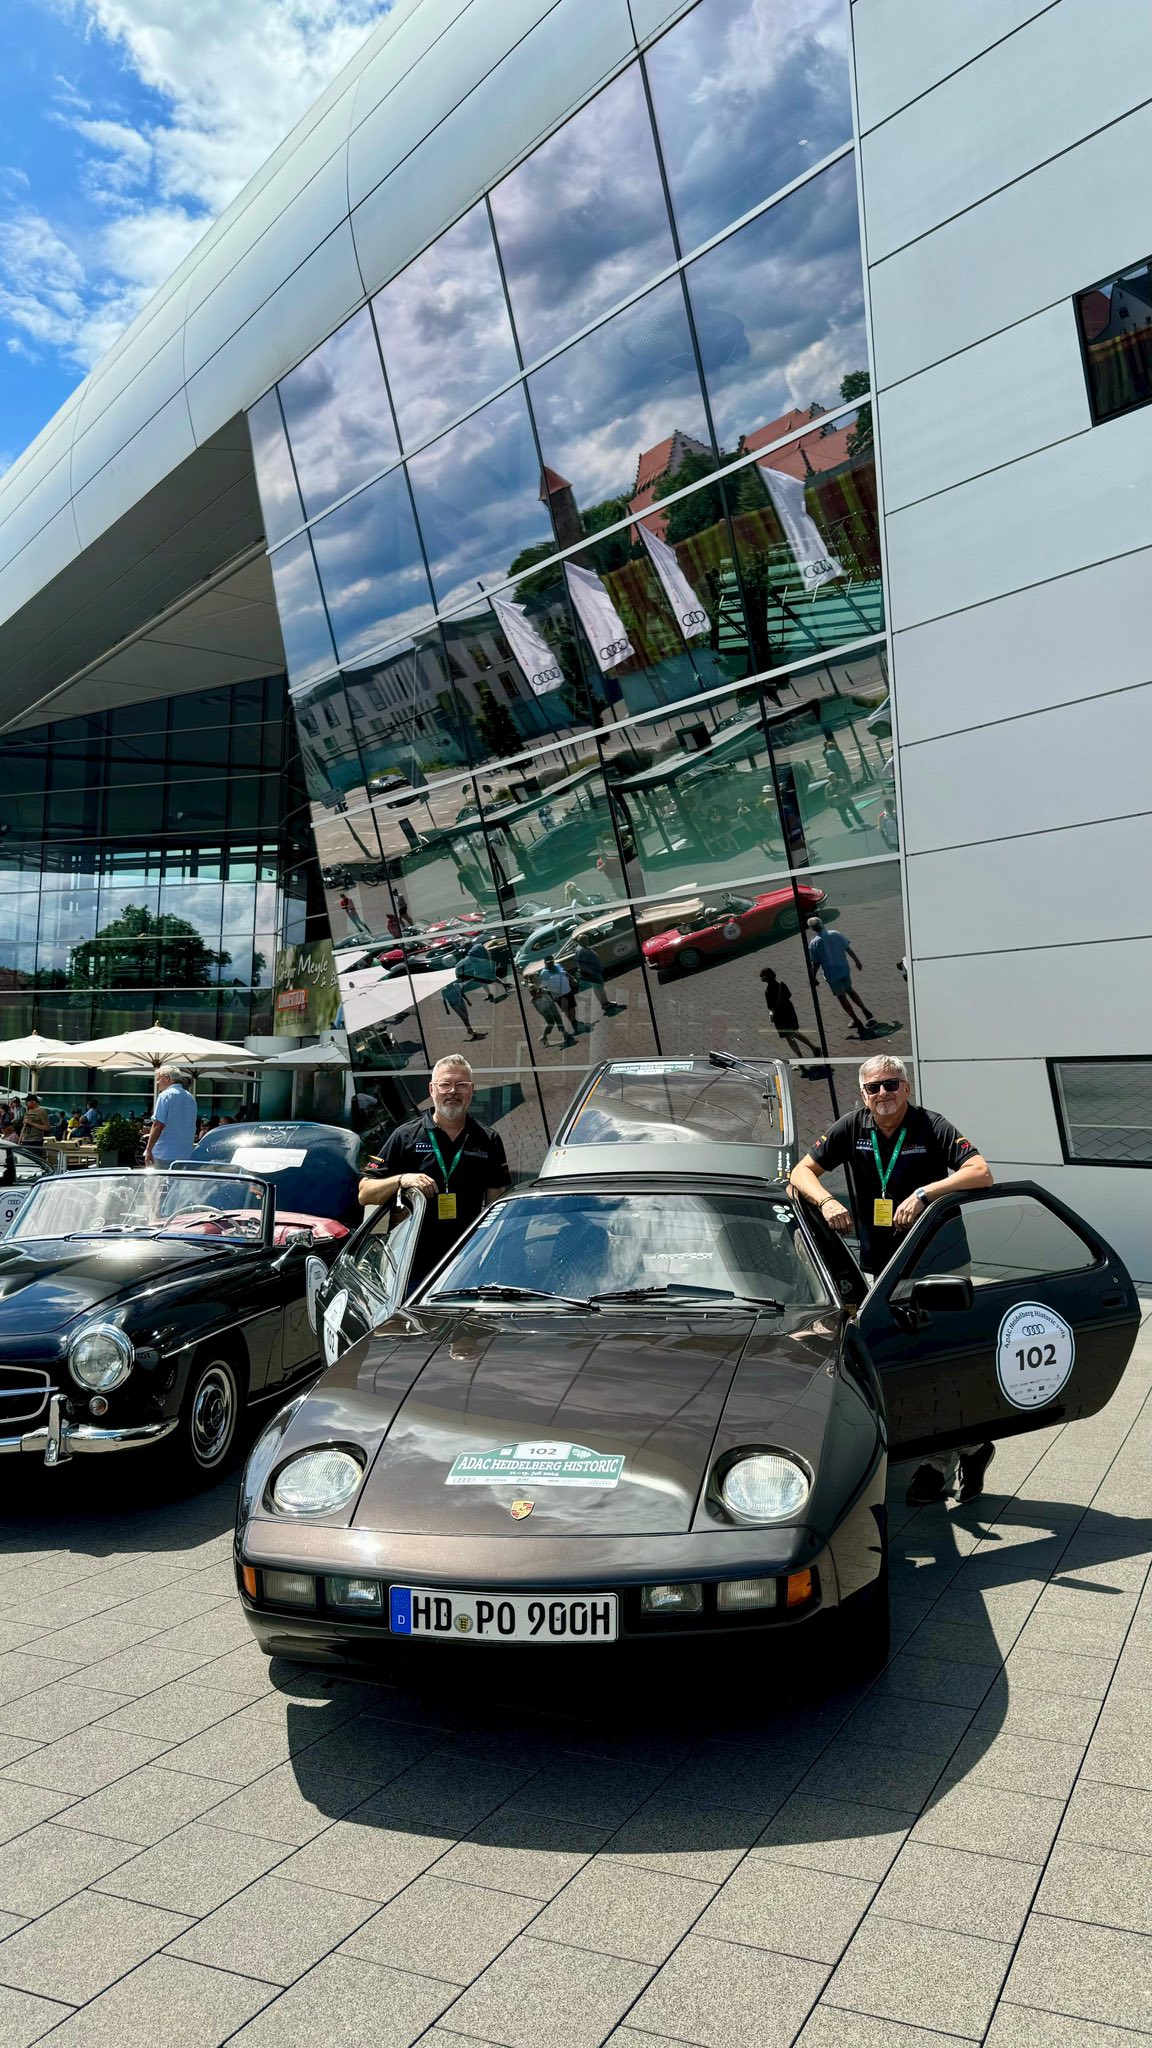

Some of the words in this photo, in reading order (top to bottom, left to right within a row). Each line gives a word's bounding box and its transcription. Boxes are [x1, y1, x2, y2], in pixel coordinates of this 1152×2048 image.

[298, 953, 328, 984] Meyle
[1009, 1311, 1034, 1330] Heidelberg
[1034, 1310, 1056, 1326] Historic
[1015, 1343, 1057, 1371] 102
[528, 1448, 557, 1456] 102
[458, 1456, 491, 1470] ADAC
[490, 1459, 562, 1471] HEIDELBERG
[563, 1459, 618, 1473] HISTORIC
[397, 1615, 405, 1625] D
[412, 1595, 452, 1631] HD
[475, 1600, 516, 1635] PO
[527, 1601, 610, 1636] 900H
